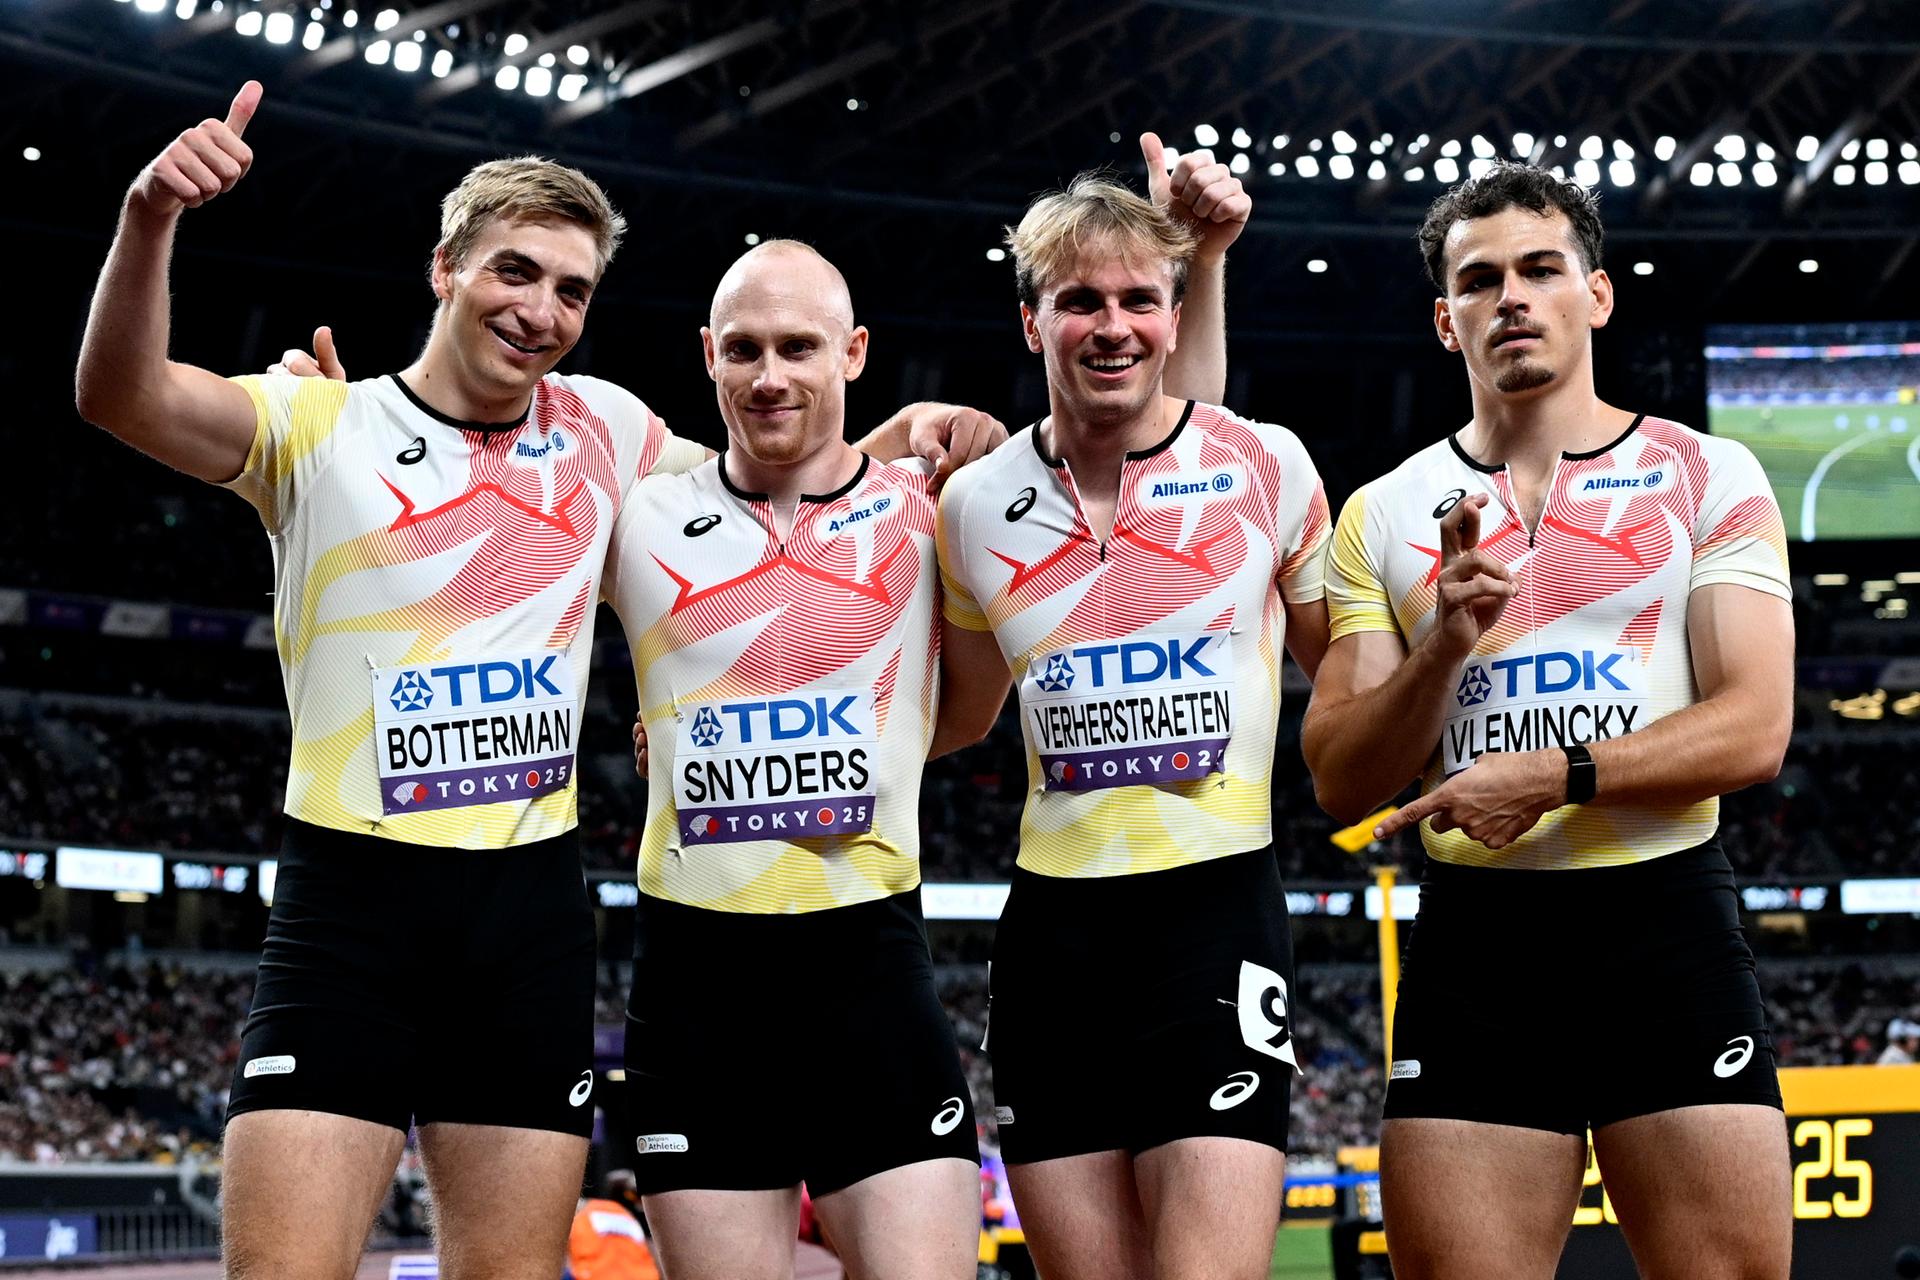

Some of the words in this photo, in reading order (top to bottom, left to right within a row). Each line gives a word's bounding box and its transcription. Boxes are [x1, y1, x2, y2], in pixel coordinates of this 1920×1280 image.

[1152, 482, 1209, 498] Allianz
[1583, 477, 1640, 491] Allianz
[431, 655, 563, 707] TDK
[1073, 636, 1217, 688] TDK
[1491, 650, 1631, 698] TDK
[387, 708, 571, 771] BOTTERMAN
[721, 695, 862, 744] TDK
[1034, 690, 1230, 750] VERHERSTRAETEN
[1450, 704, 1638, 764] VLEMINCKX
[684, 748, 869, 804] SNYDERS
[1260, 986, 1289, 1049] 9
[256, 1064, 293, 1073] Athletics
[648, 1142, 686, 1151] Athletics
[1793, 1119, 1873, 1219] 25
